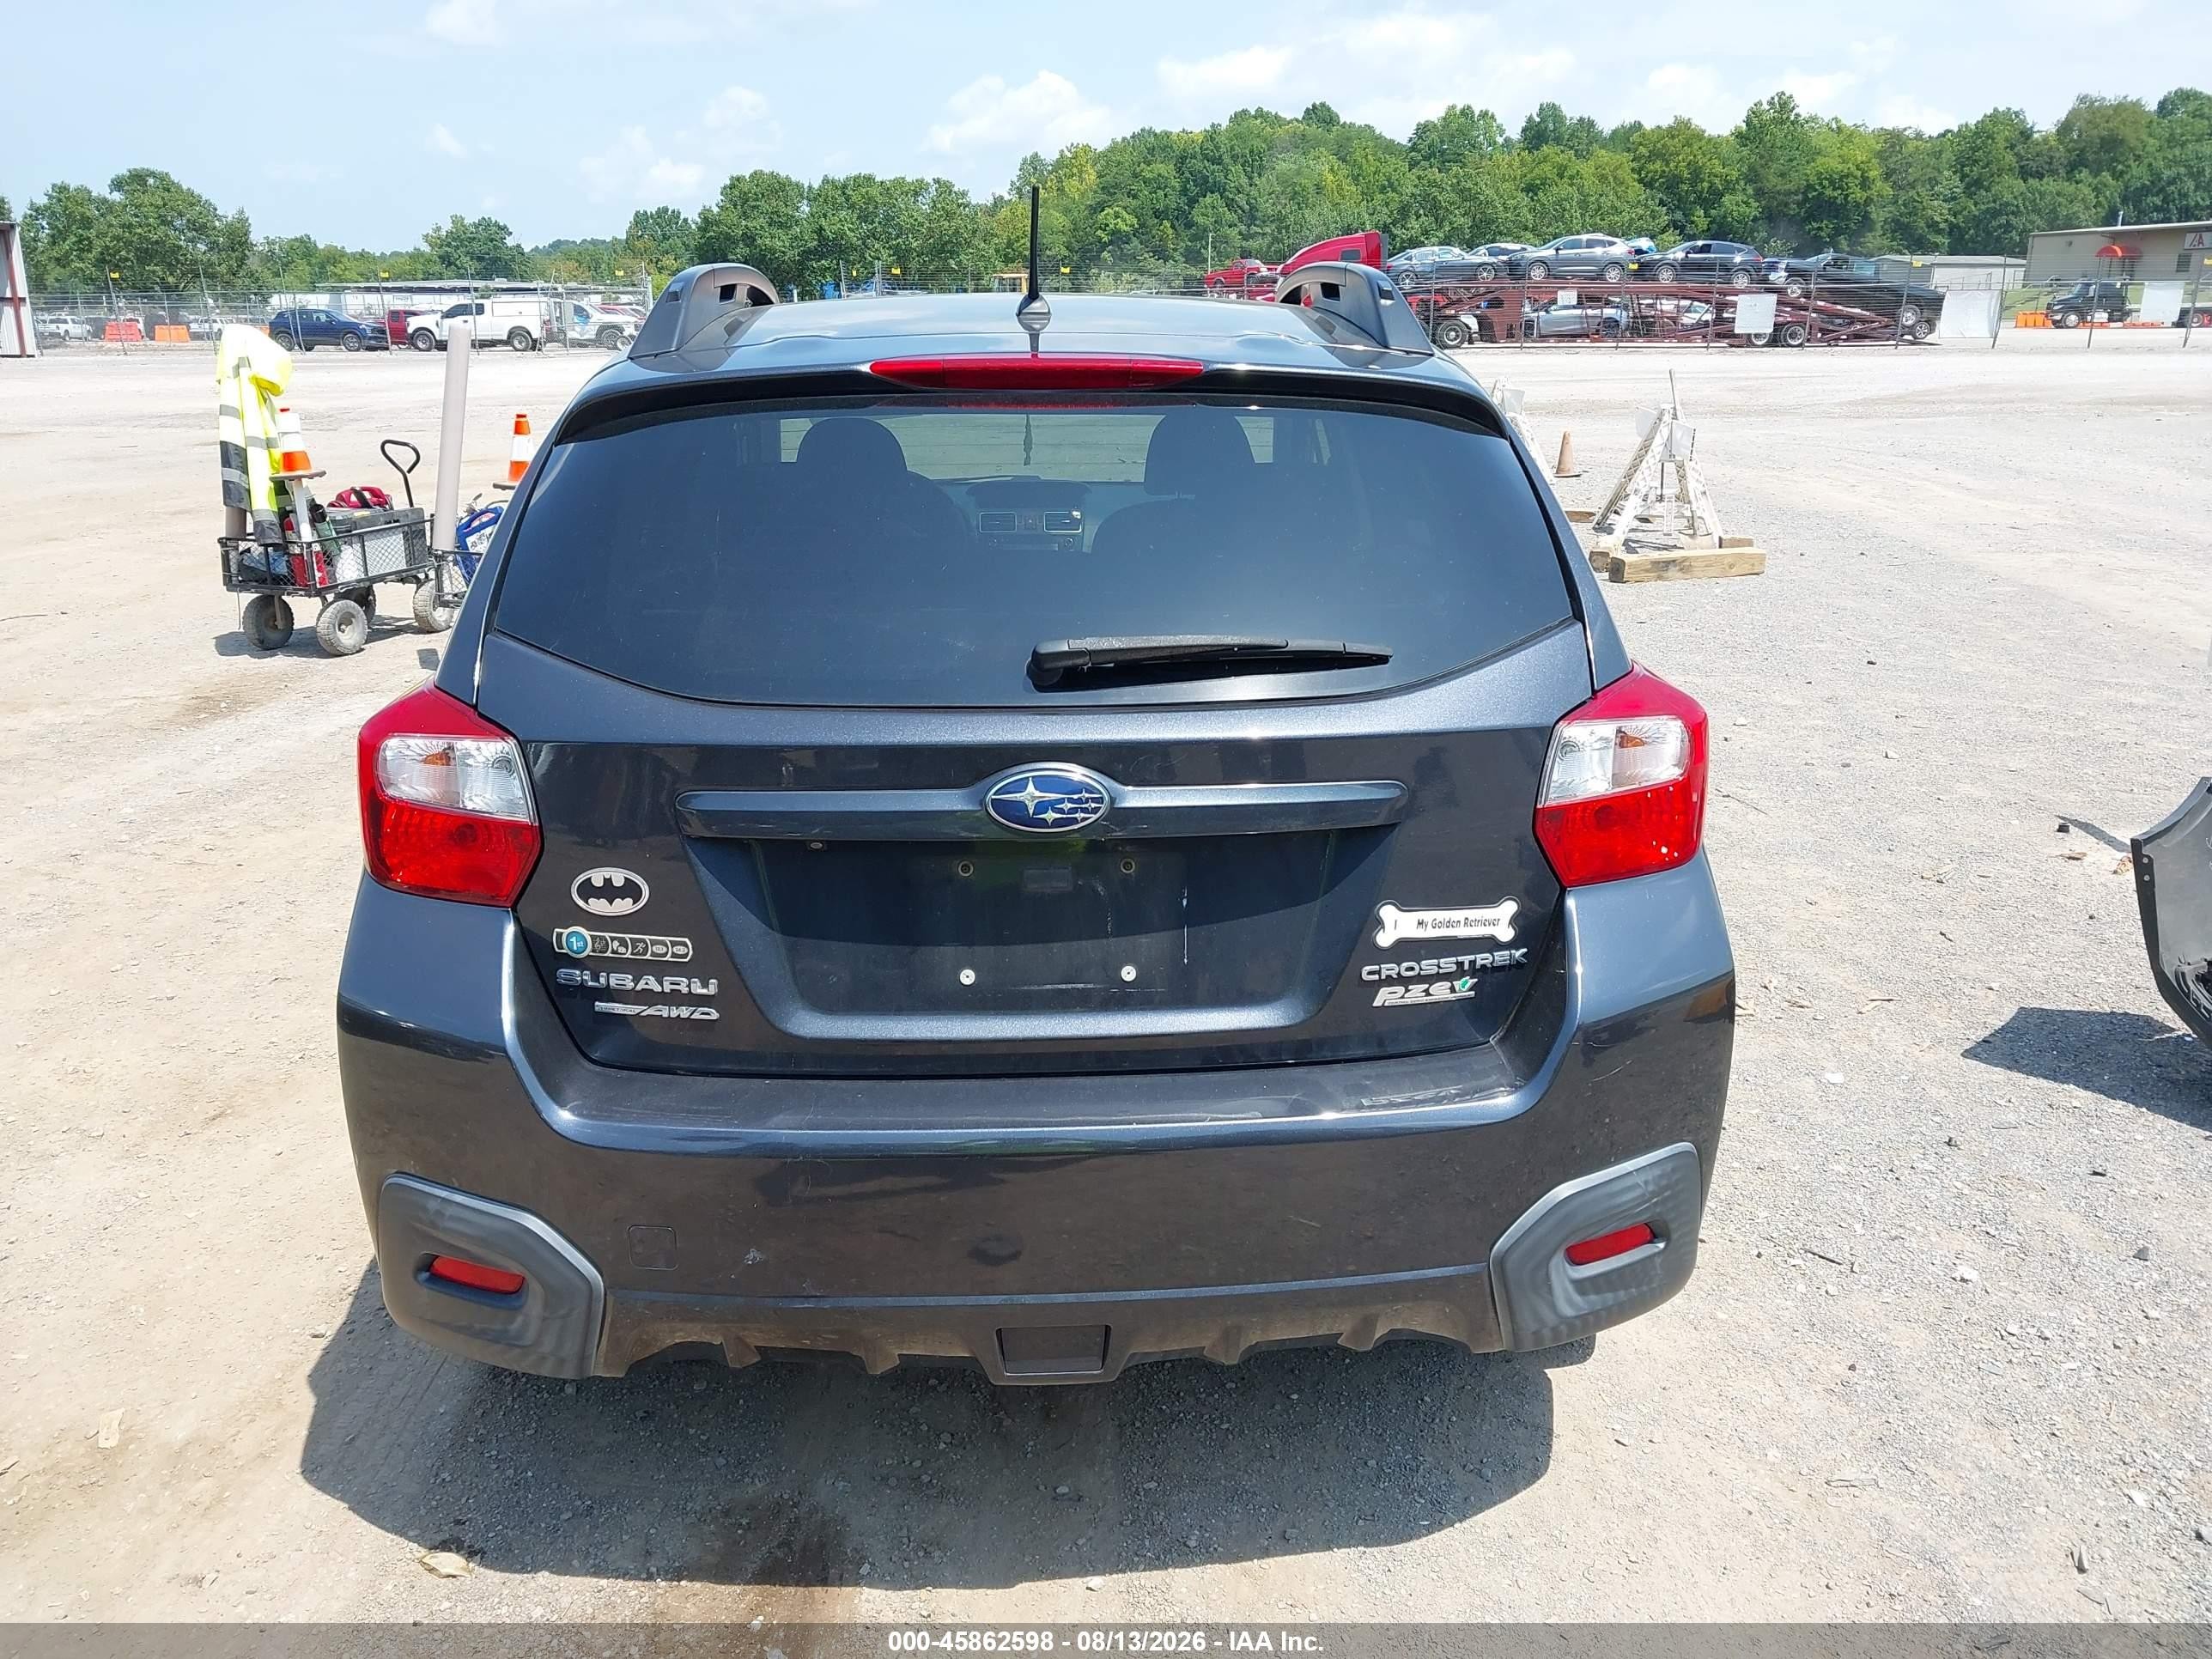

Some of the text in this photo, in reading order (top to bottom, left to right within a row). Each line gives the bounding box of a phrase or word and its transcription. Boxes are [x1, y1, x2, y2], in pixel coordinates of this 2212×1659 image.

[1416, 918, 1429, 932] My
[1431, 917, 1461, 928] Golden
[1462, 915, 1500, 928] Retriever
[1361, 948, 1528, 981] CROSSTREK
[556, 968, 718, 995] SUBARU
[638, 1005, 720, 1019] AWD
